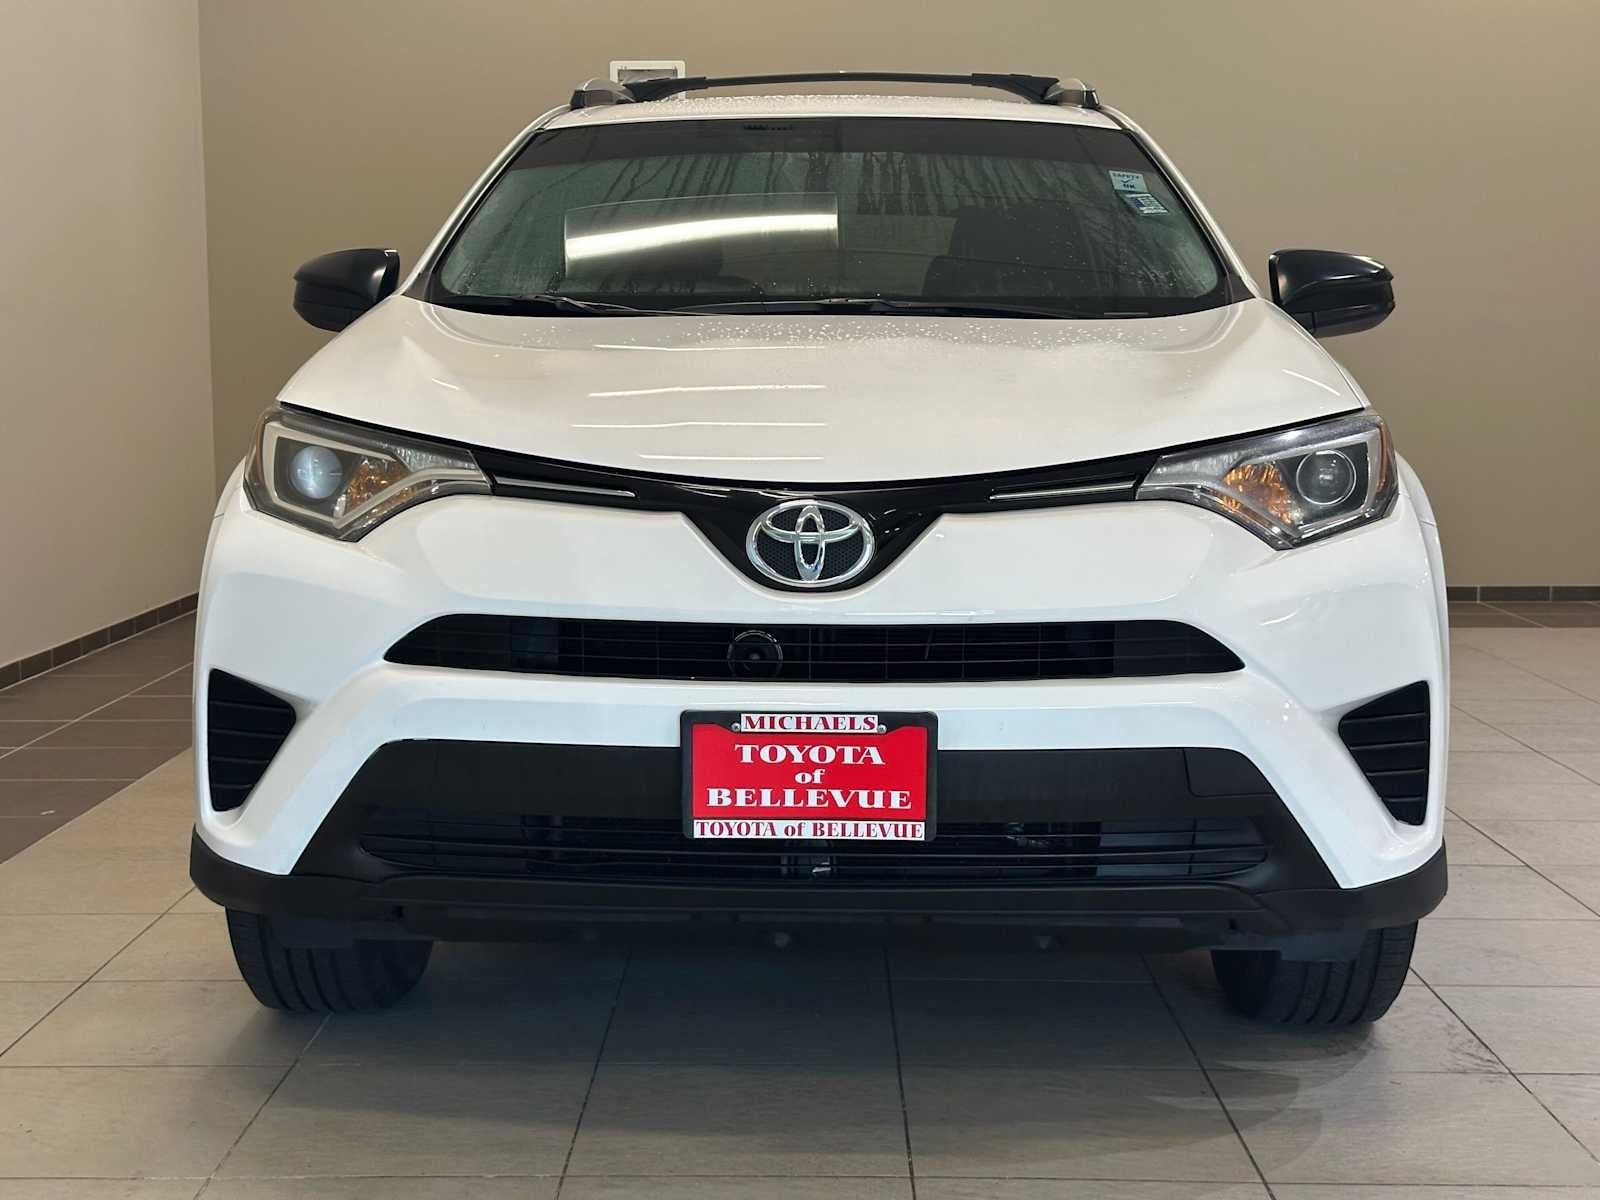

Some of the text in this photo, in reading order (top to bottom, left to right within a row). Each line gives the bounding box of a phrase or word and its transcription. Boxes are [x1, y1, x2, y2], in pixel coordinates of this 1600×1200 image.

[744, 715, 876, 731] MICHAELS
[735, 744, 886, 765] TOYOTA
[794, 768, 826, 785] of
[706, 787, 912, 809] BELLEVUE
[696, 821, 923, 839] TOYOTA of BELLEVUE
